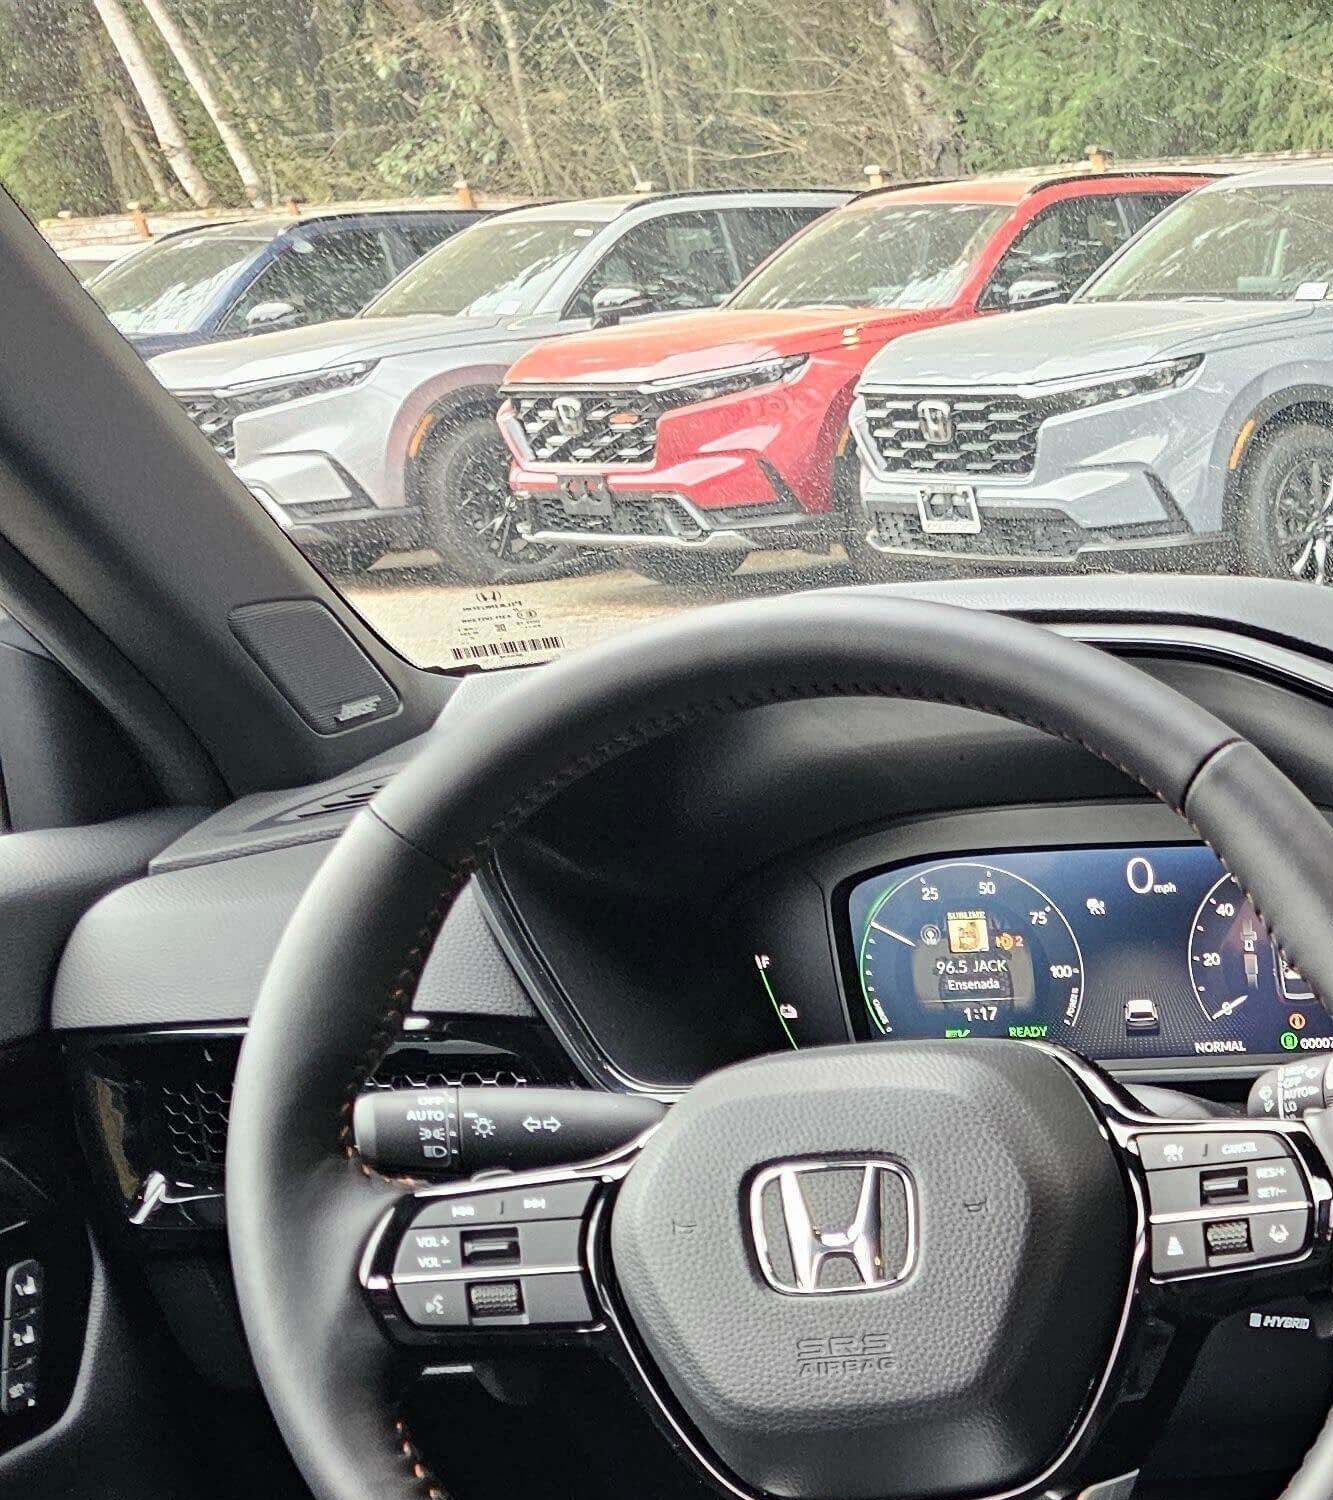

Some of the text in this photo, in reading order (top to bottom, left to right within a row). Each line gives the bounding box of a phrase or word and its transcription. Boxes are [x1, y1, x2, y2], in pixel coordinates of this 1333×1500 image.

[1126, 857, 1176, 895] 0 mph
[921, 887, 939, 901] 25
[979, 881, 996, 895] 50
[1216, 902, 1235, 917] 40
[1029, 911, 1048, 925] 75
[1015, 935, 1024, 947] 2
[1203, 952, 1221, 967] 20
[936, 959, 1008, 975] 96.5 JACK
[1050, 965, 1072, 978] 100
[947, 977, 1001, 991] Ensenada
[963, 1006, 998, 1021] 1:17
[1008, 1026, 1048, 1038] READY
[1195, 1040, 1246, 1054] NORMAL
[406, 1110, 445, 1121] AUTO
[416, 1236, 440, 1248] VOL
[418, 1256, 440, 1268] VOL
[1263, 1315, 1310, 1330] HYBRID
[796, 1332, 889, 1357] SRS
[800, 1357, 896, 1377] AIRBAG
